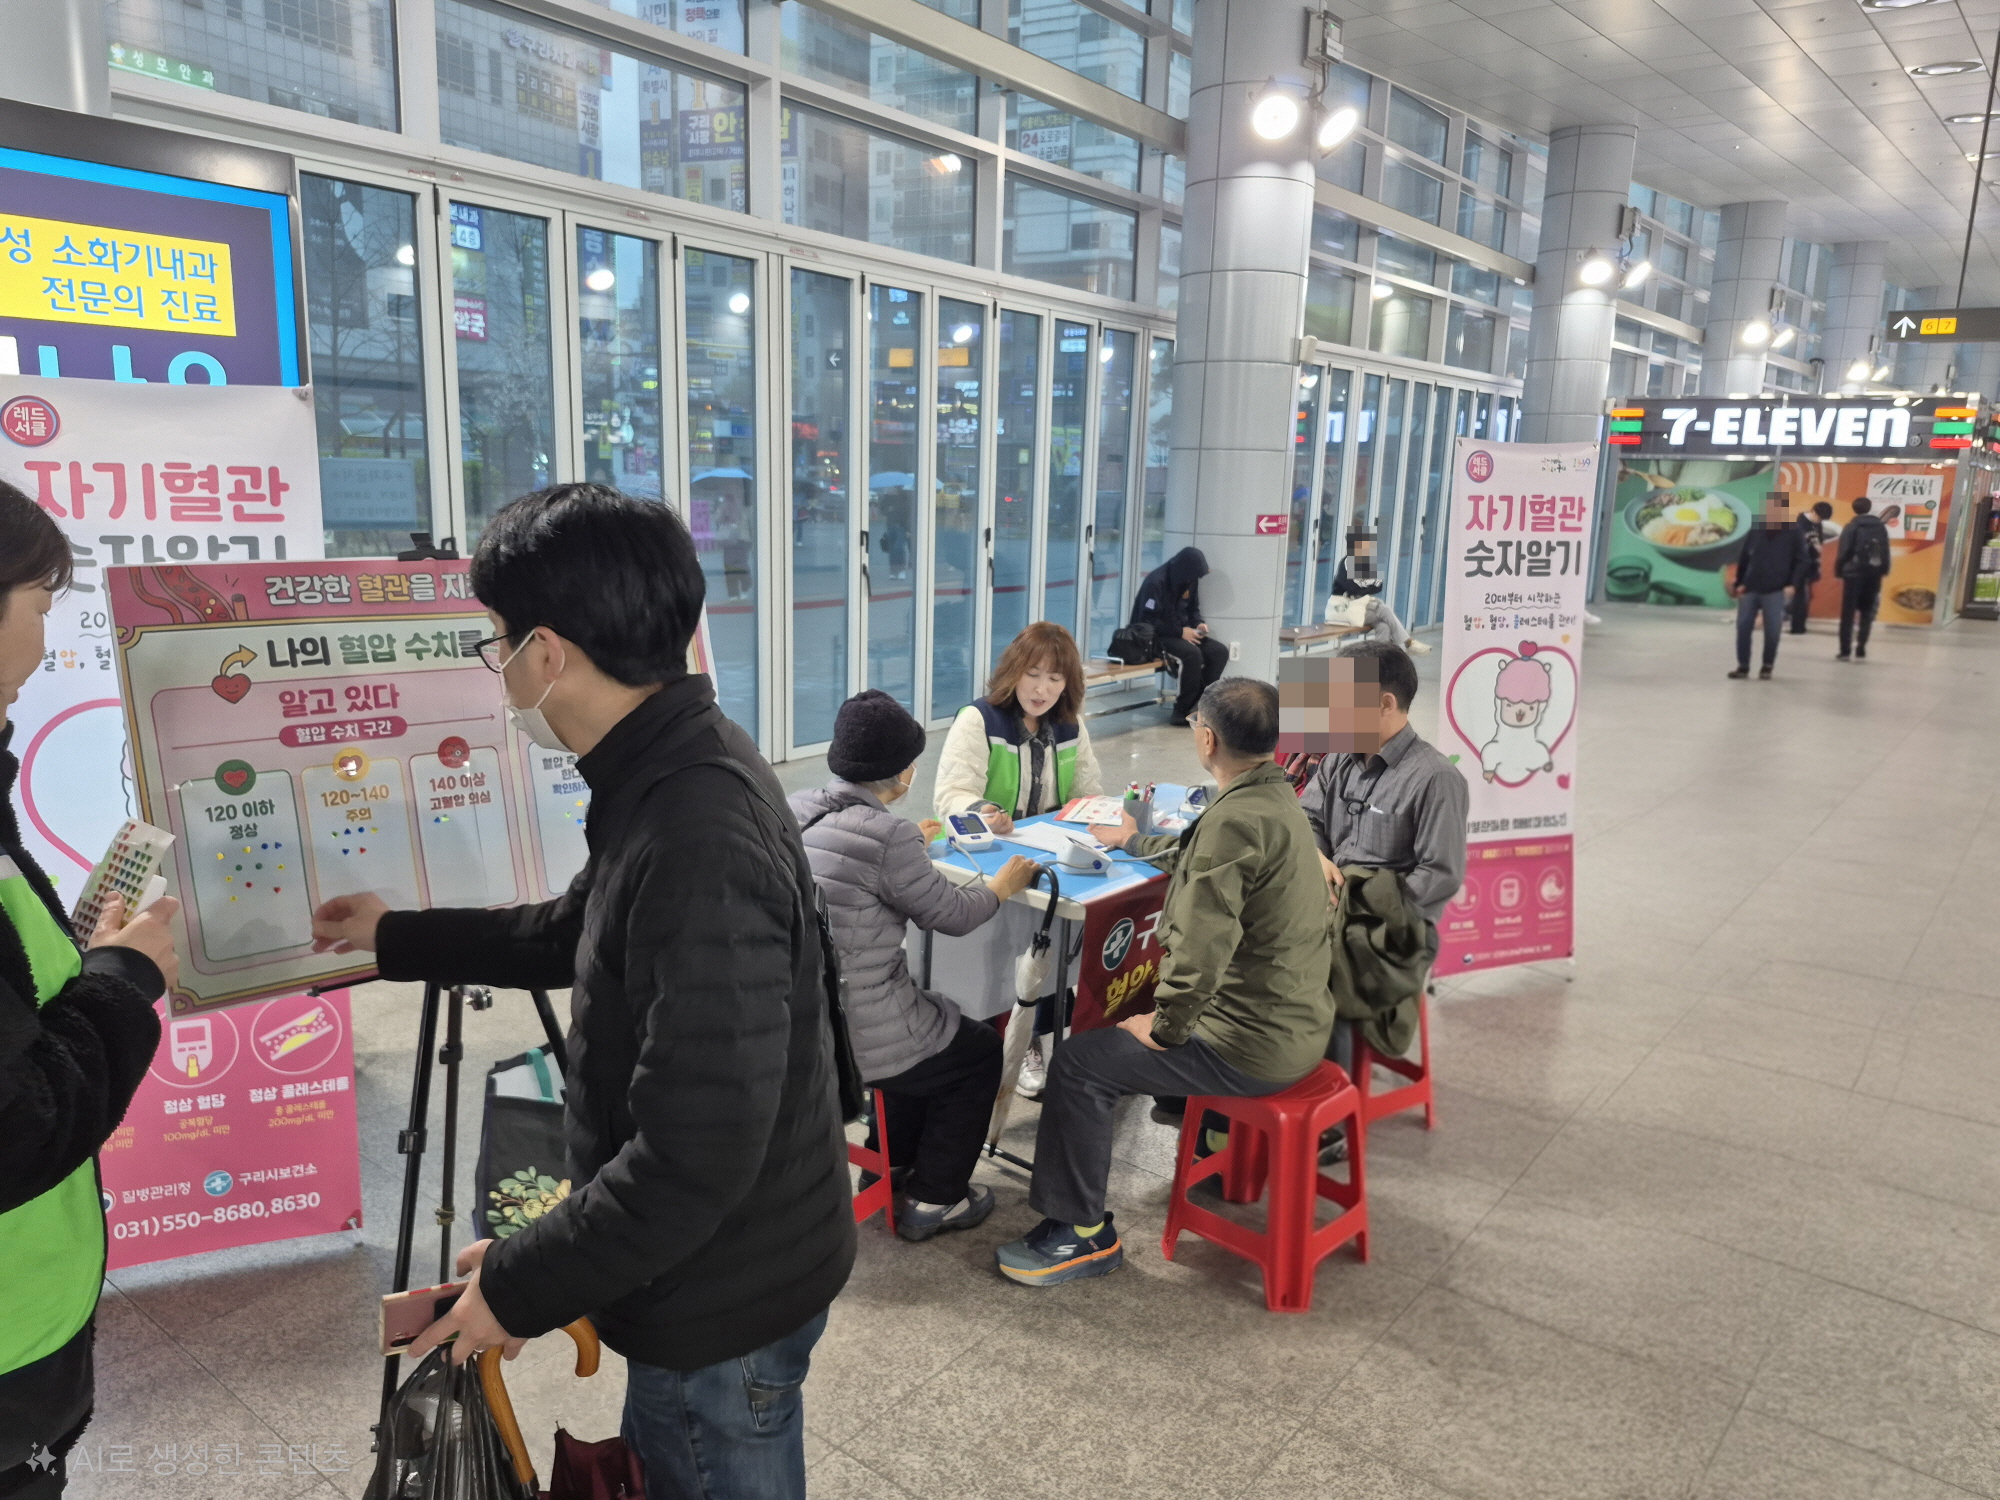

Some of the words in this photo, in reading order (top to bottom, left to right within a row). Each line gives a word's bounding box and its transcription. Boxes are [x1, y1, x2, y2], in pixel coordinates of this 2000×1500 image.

[52, 235, 219, 285] 소화기내과
[42, 276, 145, 319] 전문의
[160, 289, 222, 323] 진료
[13, 406, 47, 421] 레드
[15, 421, 47, 437] 서클
[1472, 456, 1488, 467] 레드
[24, 461, 290, 523] 자기혈관
[1465, 494, 1587, 533] 자기혈관
[1463, 539, 1582, 578] 숫자알기
[264, 573, 352, 606] 건강한
[357, 572, 437, 602] 혈관을
[1484, 592, 1523, 605] 20대부터
[267, 635, 331, 668] 나의
[338, 632, 397, 665] 혈압
[405, 629, 482, 661] 수치를
[279, 688, 337, 718] 알고
[344, 683, 400, 713] 있다
[296, 727, 326, 742] 혈압
[331, 724, 360, 740] 수치
[364, 720, 392, 736] 구간
[429, 775, 456, 792] 140
[461, 772, 486, 788] 이상
[321, 784, 389, 807] 120~140
[429, 792, 466, 811] 고혈압
[469, 789, 491, 805] 의심
[204, 804, 238, 823] 120
[242, 799, 275, 818] 이하
[345, 807, 372, 823] 주의
[229, 823, 258, 841] 정상
[248, 1086, 278, 1103] 정상
[281, 1075, 350, 1100] 콜레스테롤
[163, 1097, 193, 1115] 정상
[196, 1093, 227, 1110] 혈당
[318, 1109, 335, 1121] 미만
[116, 1126, 135, 1138] 미만
[213, 1124, 231, 1136] 미만
[115, 1138, 134, 1149] 미만
[238, 1163, 319, 1187] 구리시보건소
[121, 1182, 192, 1204] 질병관리청
